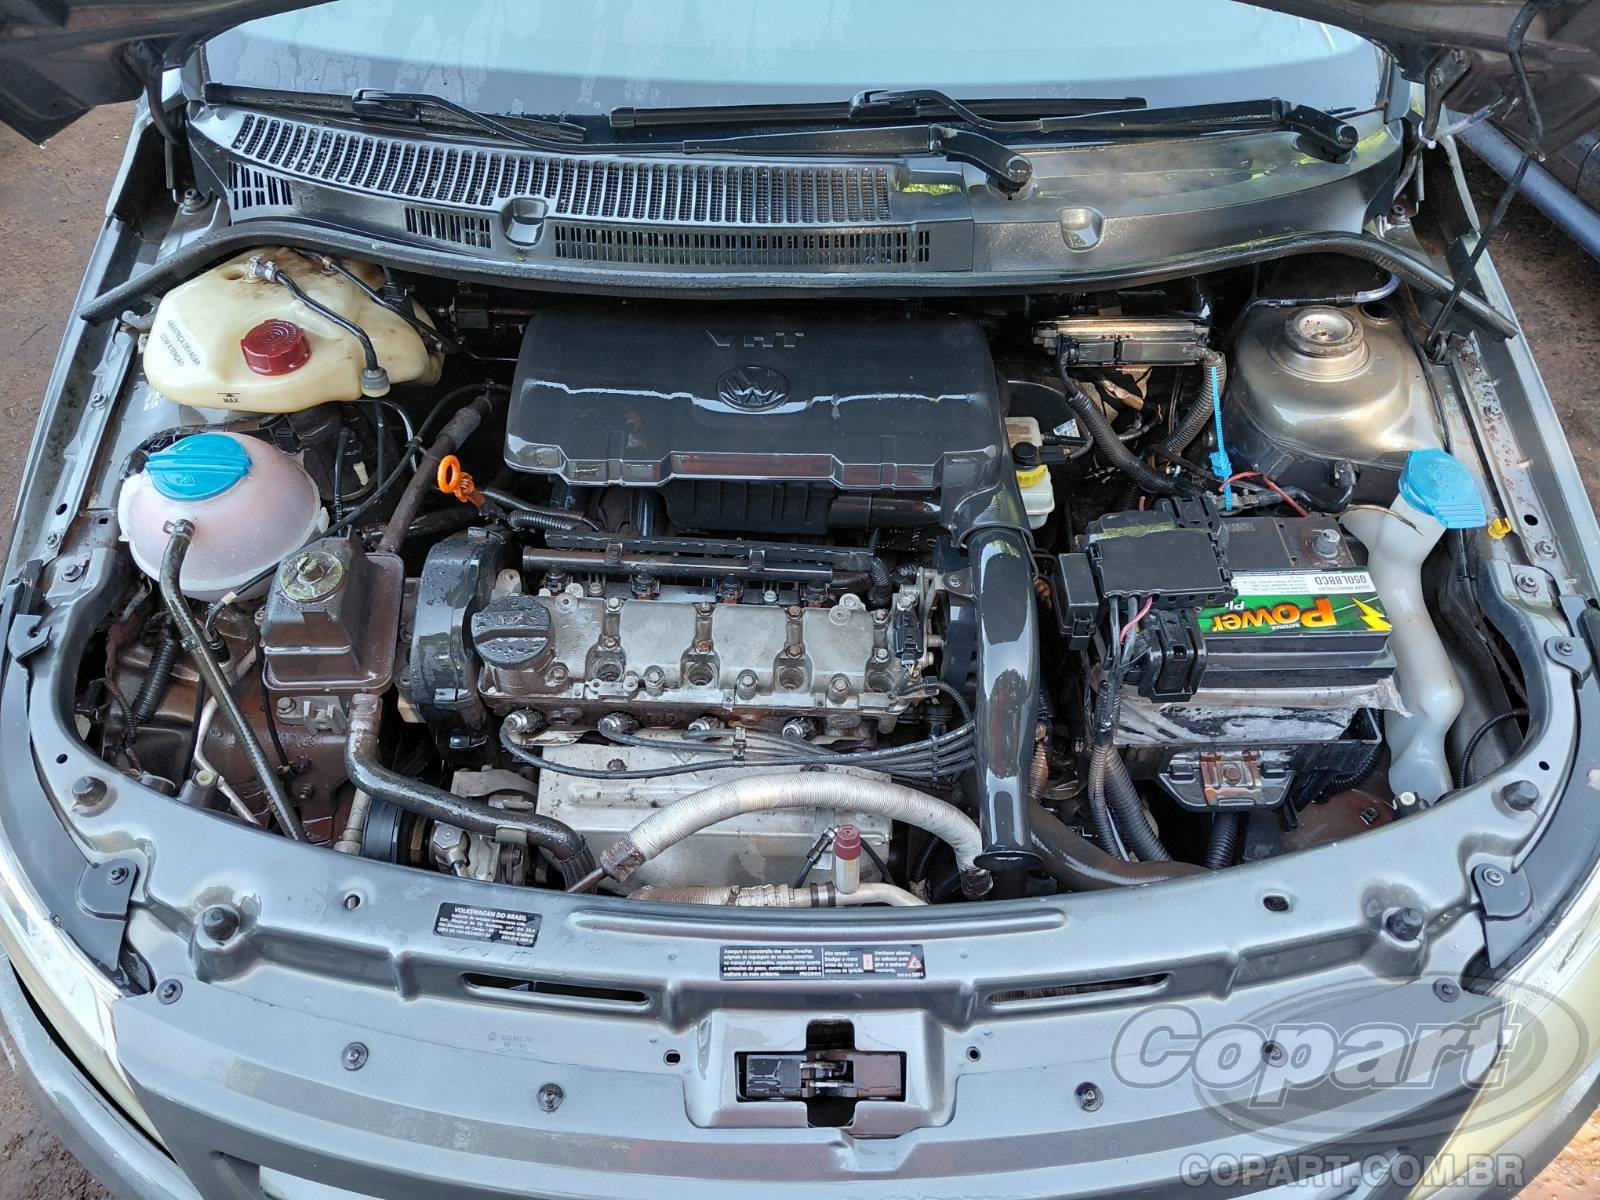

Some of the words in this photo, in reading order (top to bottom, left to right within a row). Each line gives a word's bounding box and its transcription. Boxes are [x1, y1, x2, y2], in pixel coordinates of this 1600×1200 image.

[1212, 597, 1338, 632] Power
[454, 906, 496, 918] VOLKSWAGEN
[507, 912, 527, 921] BRASIL
